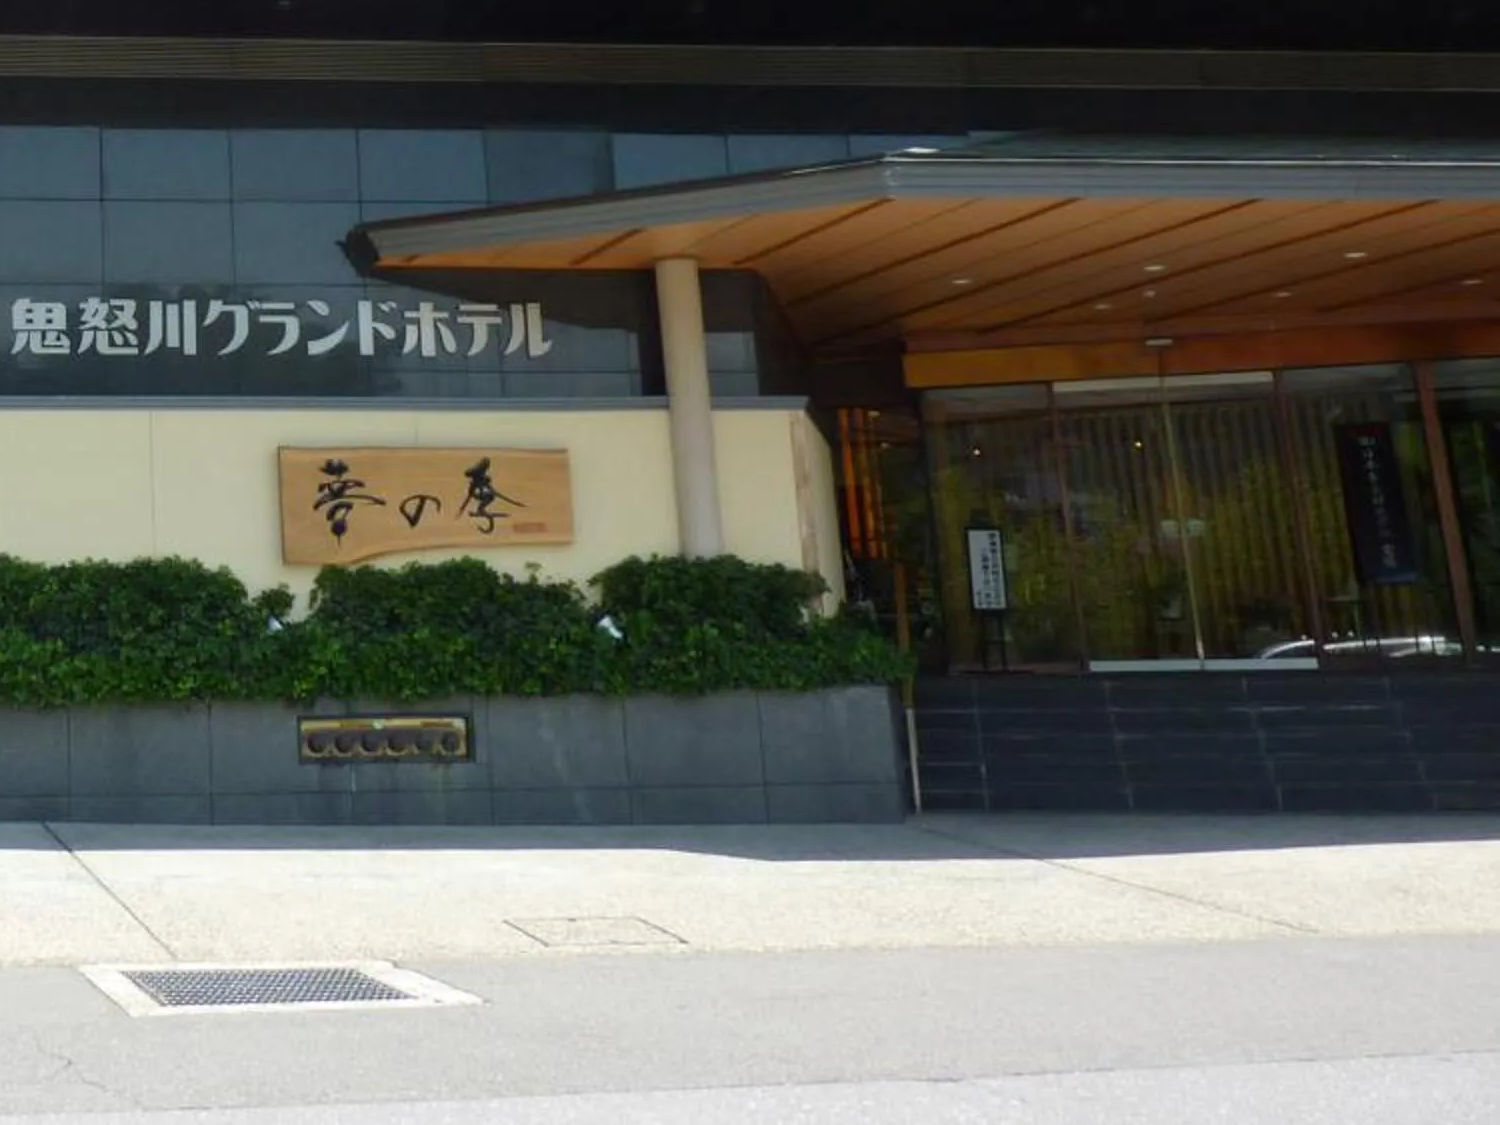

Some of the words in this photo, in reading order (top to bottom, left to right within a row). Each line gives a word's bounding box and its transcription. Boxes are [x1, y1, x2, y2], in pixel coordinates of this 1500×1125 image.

[11, 297, 553, 357] 鬼怒川グランドホテル
